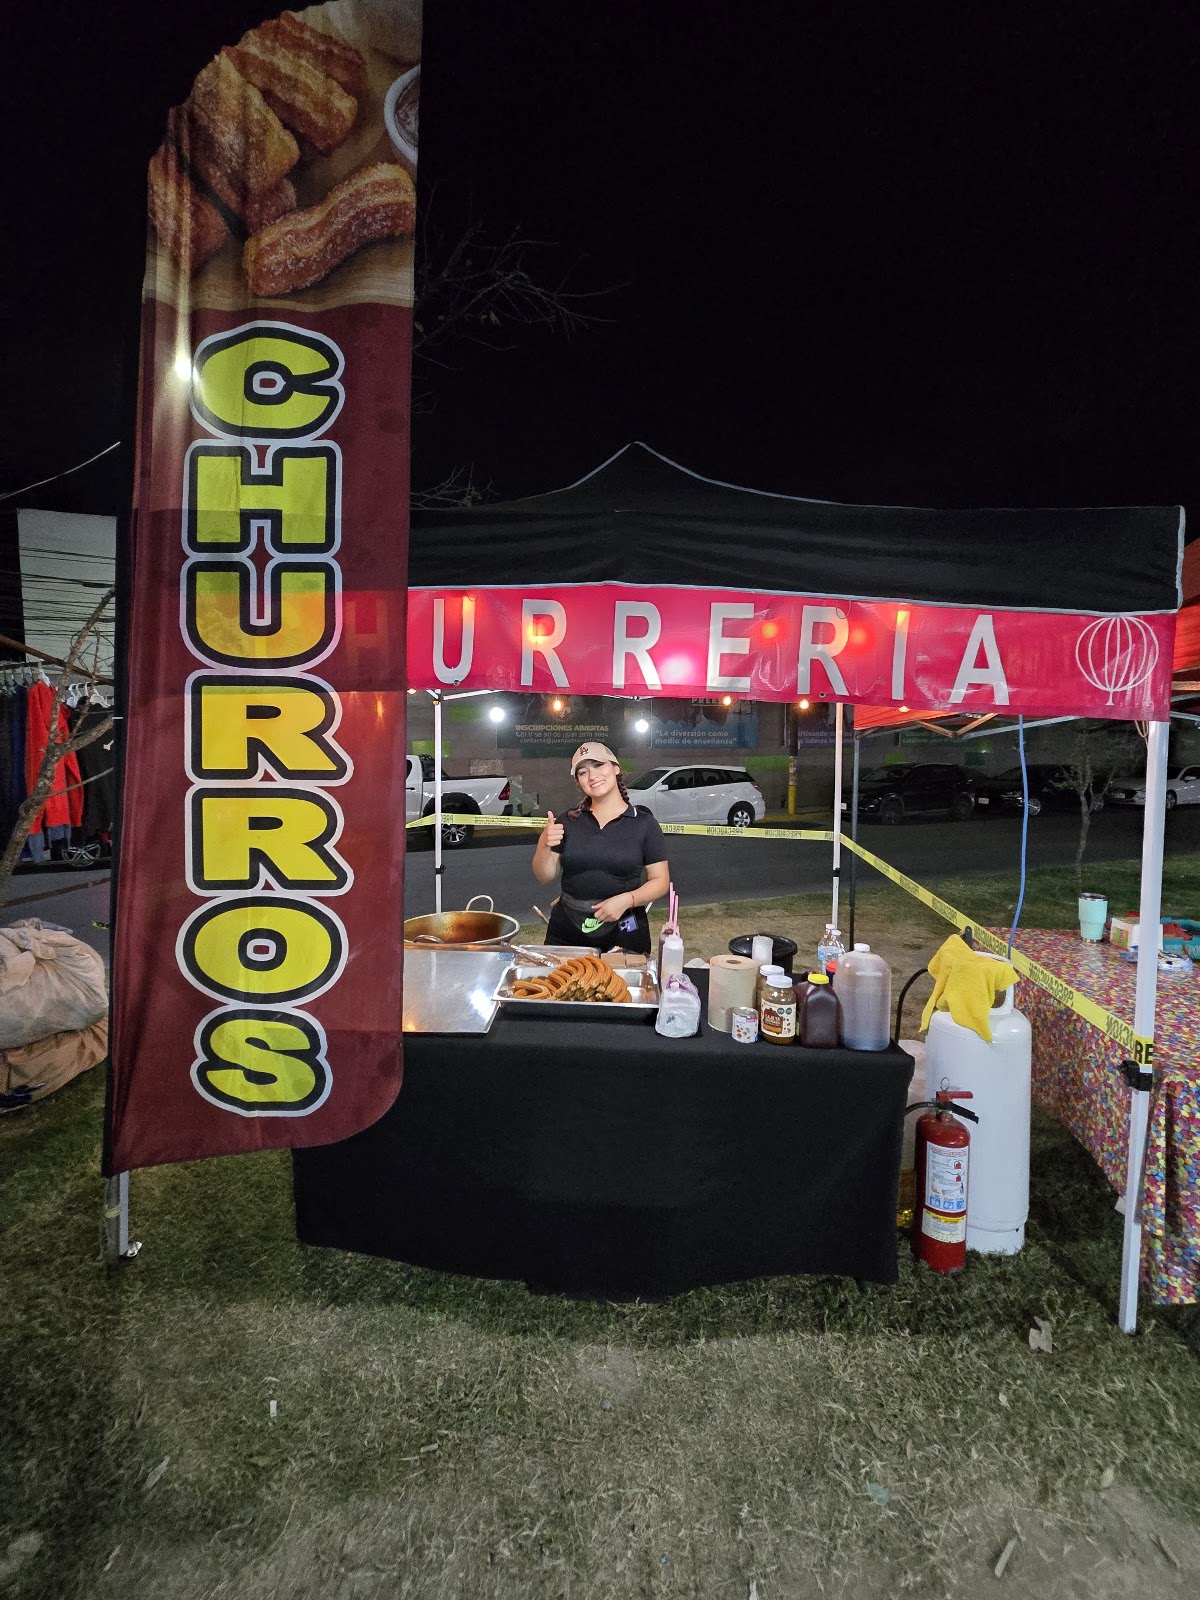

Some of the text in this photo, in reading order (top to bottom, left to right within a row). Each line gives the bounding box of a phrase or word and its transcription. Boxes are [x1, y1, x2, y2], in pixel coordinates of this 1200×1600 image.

[175, 319, 355, 1119] CHURROS
[515, 724, 573, 732] INSCRIPCIONES
[670, 729, 706, 737] diversión
[655, 737, 680, 745] medio
[681, 737, 692, 745] de
